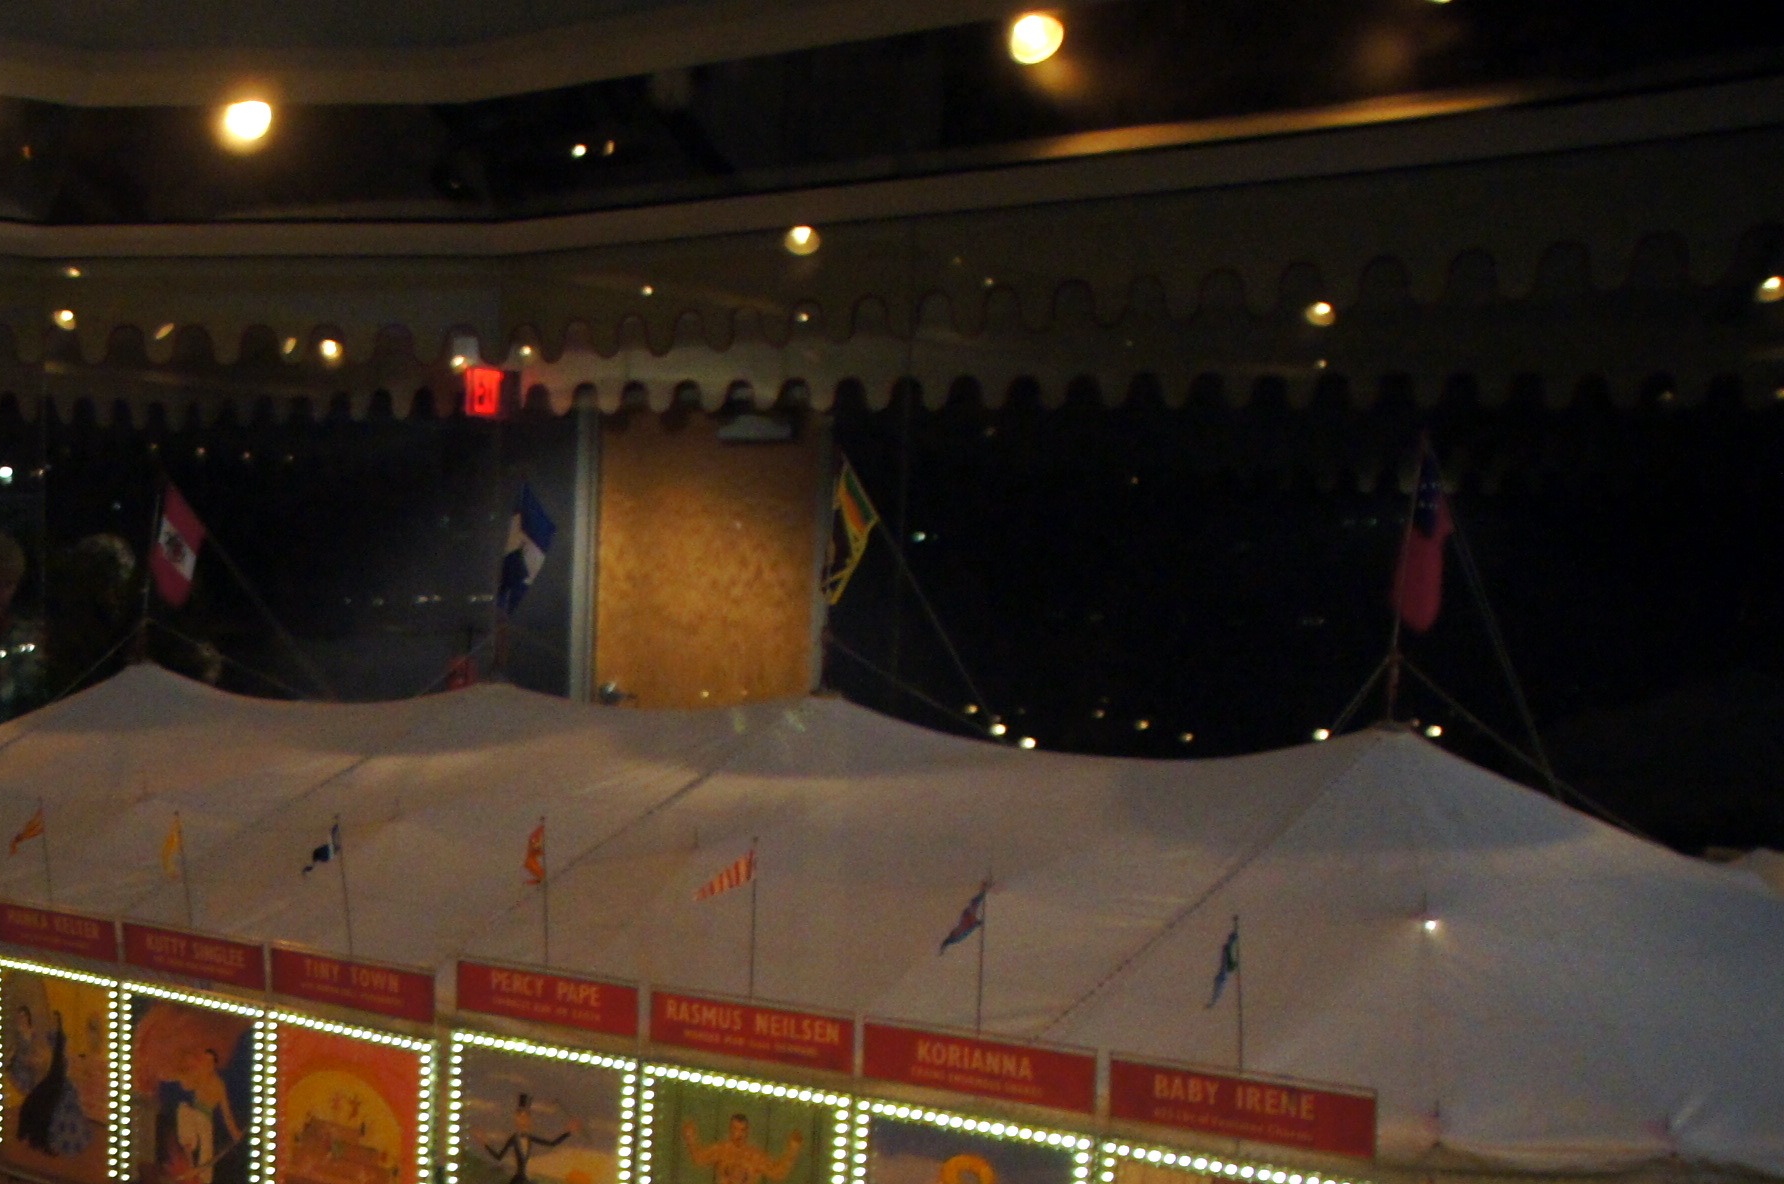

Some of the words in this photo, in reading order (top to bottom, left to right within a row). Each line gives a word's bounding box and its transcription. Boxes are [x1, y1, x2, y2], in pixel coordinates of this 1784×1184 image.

[304, 956, 340, 981] TINY
[350, 966, 401, 994] TOWN
[491, 968, 544, 998] PERCY
[556, 980, 602, 1007] PAPE
[667, 999, 743, 1032] RASMUS
[755, 1012, 840, 1045] NEILSEN
[917, 1039, 1034, 1081] KORIANNA
[1154, 1073, 1220, 1105] BABY
[1234, 1085, 1316, 1121] IRENE
